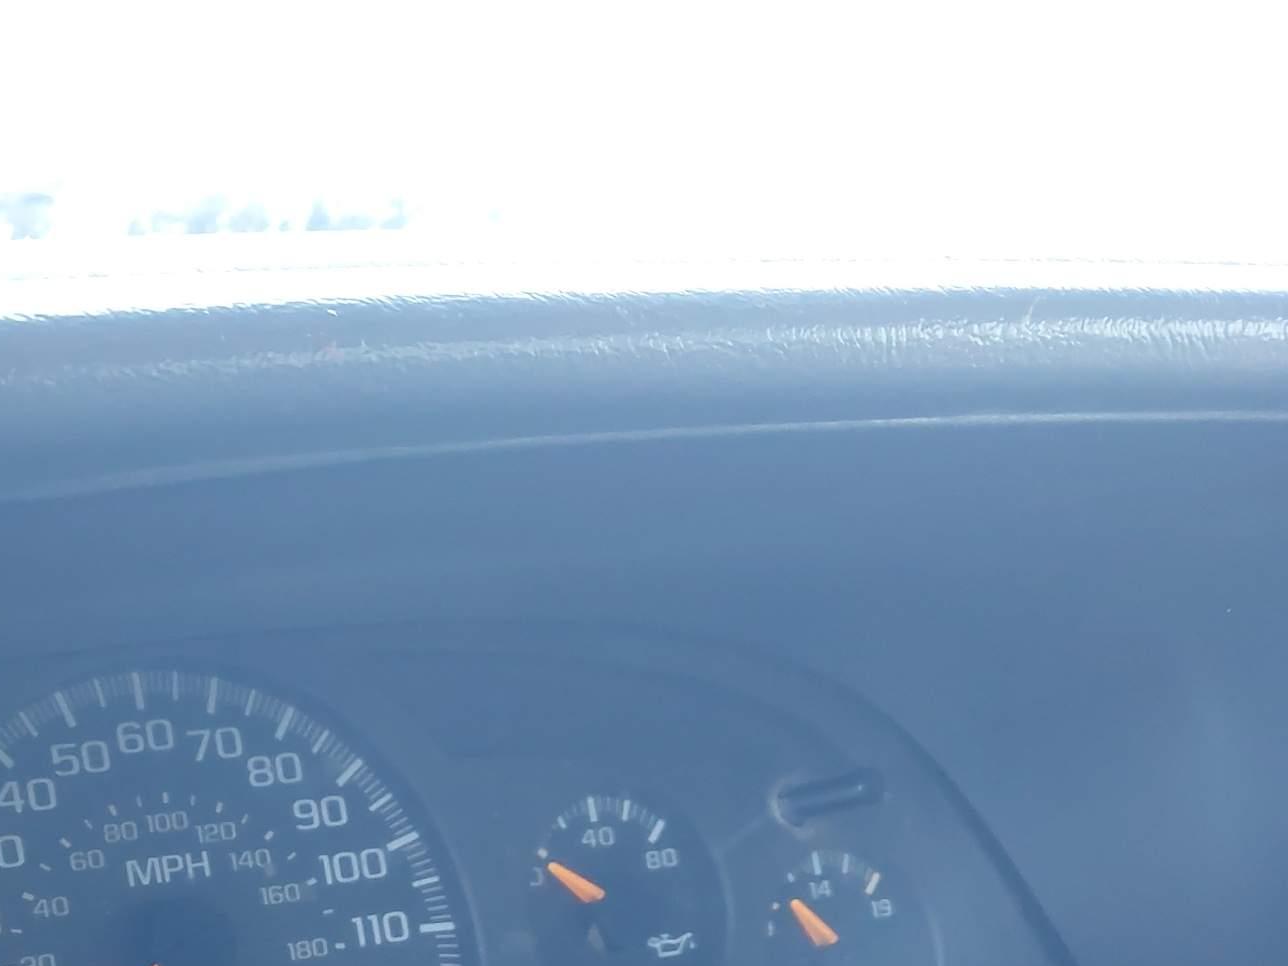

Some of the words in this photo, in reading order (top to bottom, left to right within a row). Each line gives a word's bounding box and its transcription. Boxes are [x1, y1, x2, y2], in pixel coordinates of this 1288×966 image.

[116, 719, 175, 754] 60
[185, 726, 244, 762] 70
[49, 740, 111, 777] 50
[246, 752, 304, 788] 80
[145, 810, 189, 834] 100
[292, 794, 349, 831] 90
[103, 820, 139, 844] 80
[194, 821, 238, 844] 120
[581, 826, 616, 849] 40
[69, 849, 106, 872] 60
[125, 849, 212, 887] MPH
[229, 848, 272, 872] 140
[318, 847, 388, 886] 100
[645, 847, 679, 870] 80
[258, 882, 302, 906] 160
[809, 878, 833, 900] 14
[32, 896, 70, 919] 40
[351, 910, 410, 948] 110
[286, 937, 329, 961] 180
